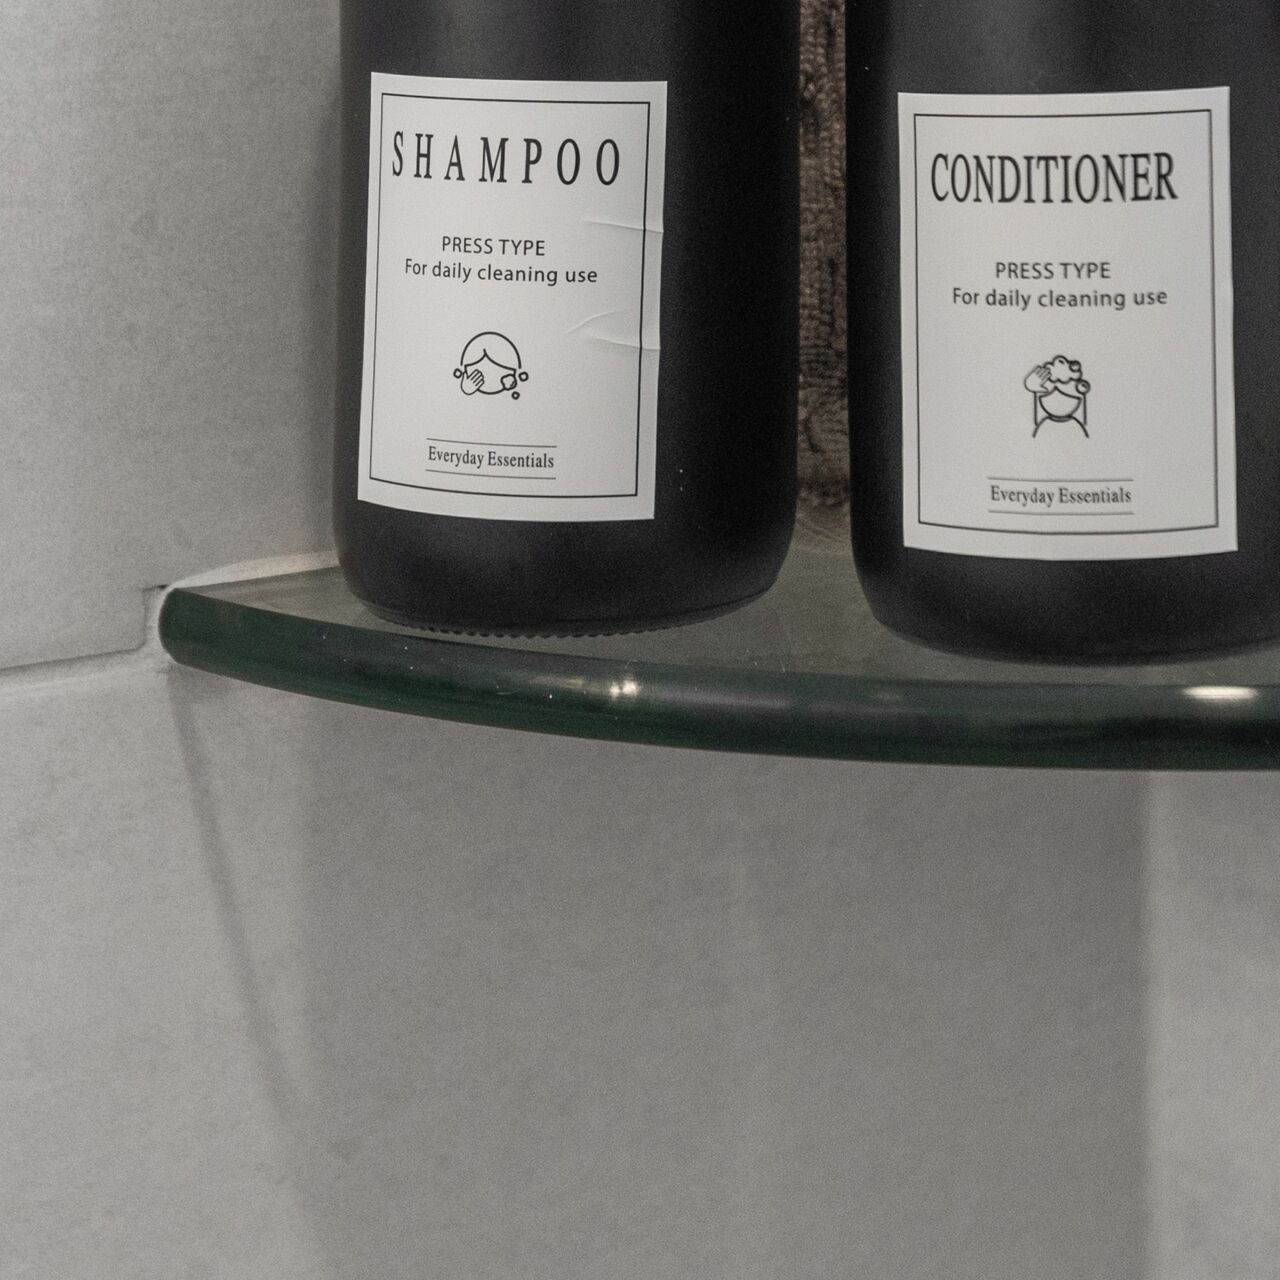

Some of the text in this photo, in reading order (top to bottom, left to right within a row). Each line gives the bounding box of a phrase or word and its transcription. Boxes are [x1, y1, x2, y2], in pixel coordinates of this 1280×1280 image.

[392, 130, 620, 186] SHAMPOO
[930, 151, 1179, 204] CONDITIONER
[442, 235, 545, 257] PRESS TYPE
[405, 257, 598, 287] For daily cleaning use
[995, 261, 1111, 280] PRESS TYPE
[952, 287, 1168, 312] For daily cleaning use
[428, 446, 555, 469] Everyday Essentials
[990, 484, 1132, 507] Everyday Essentials
